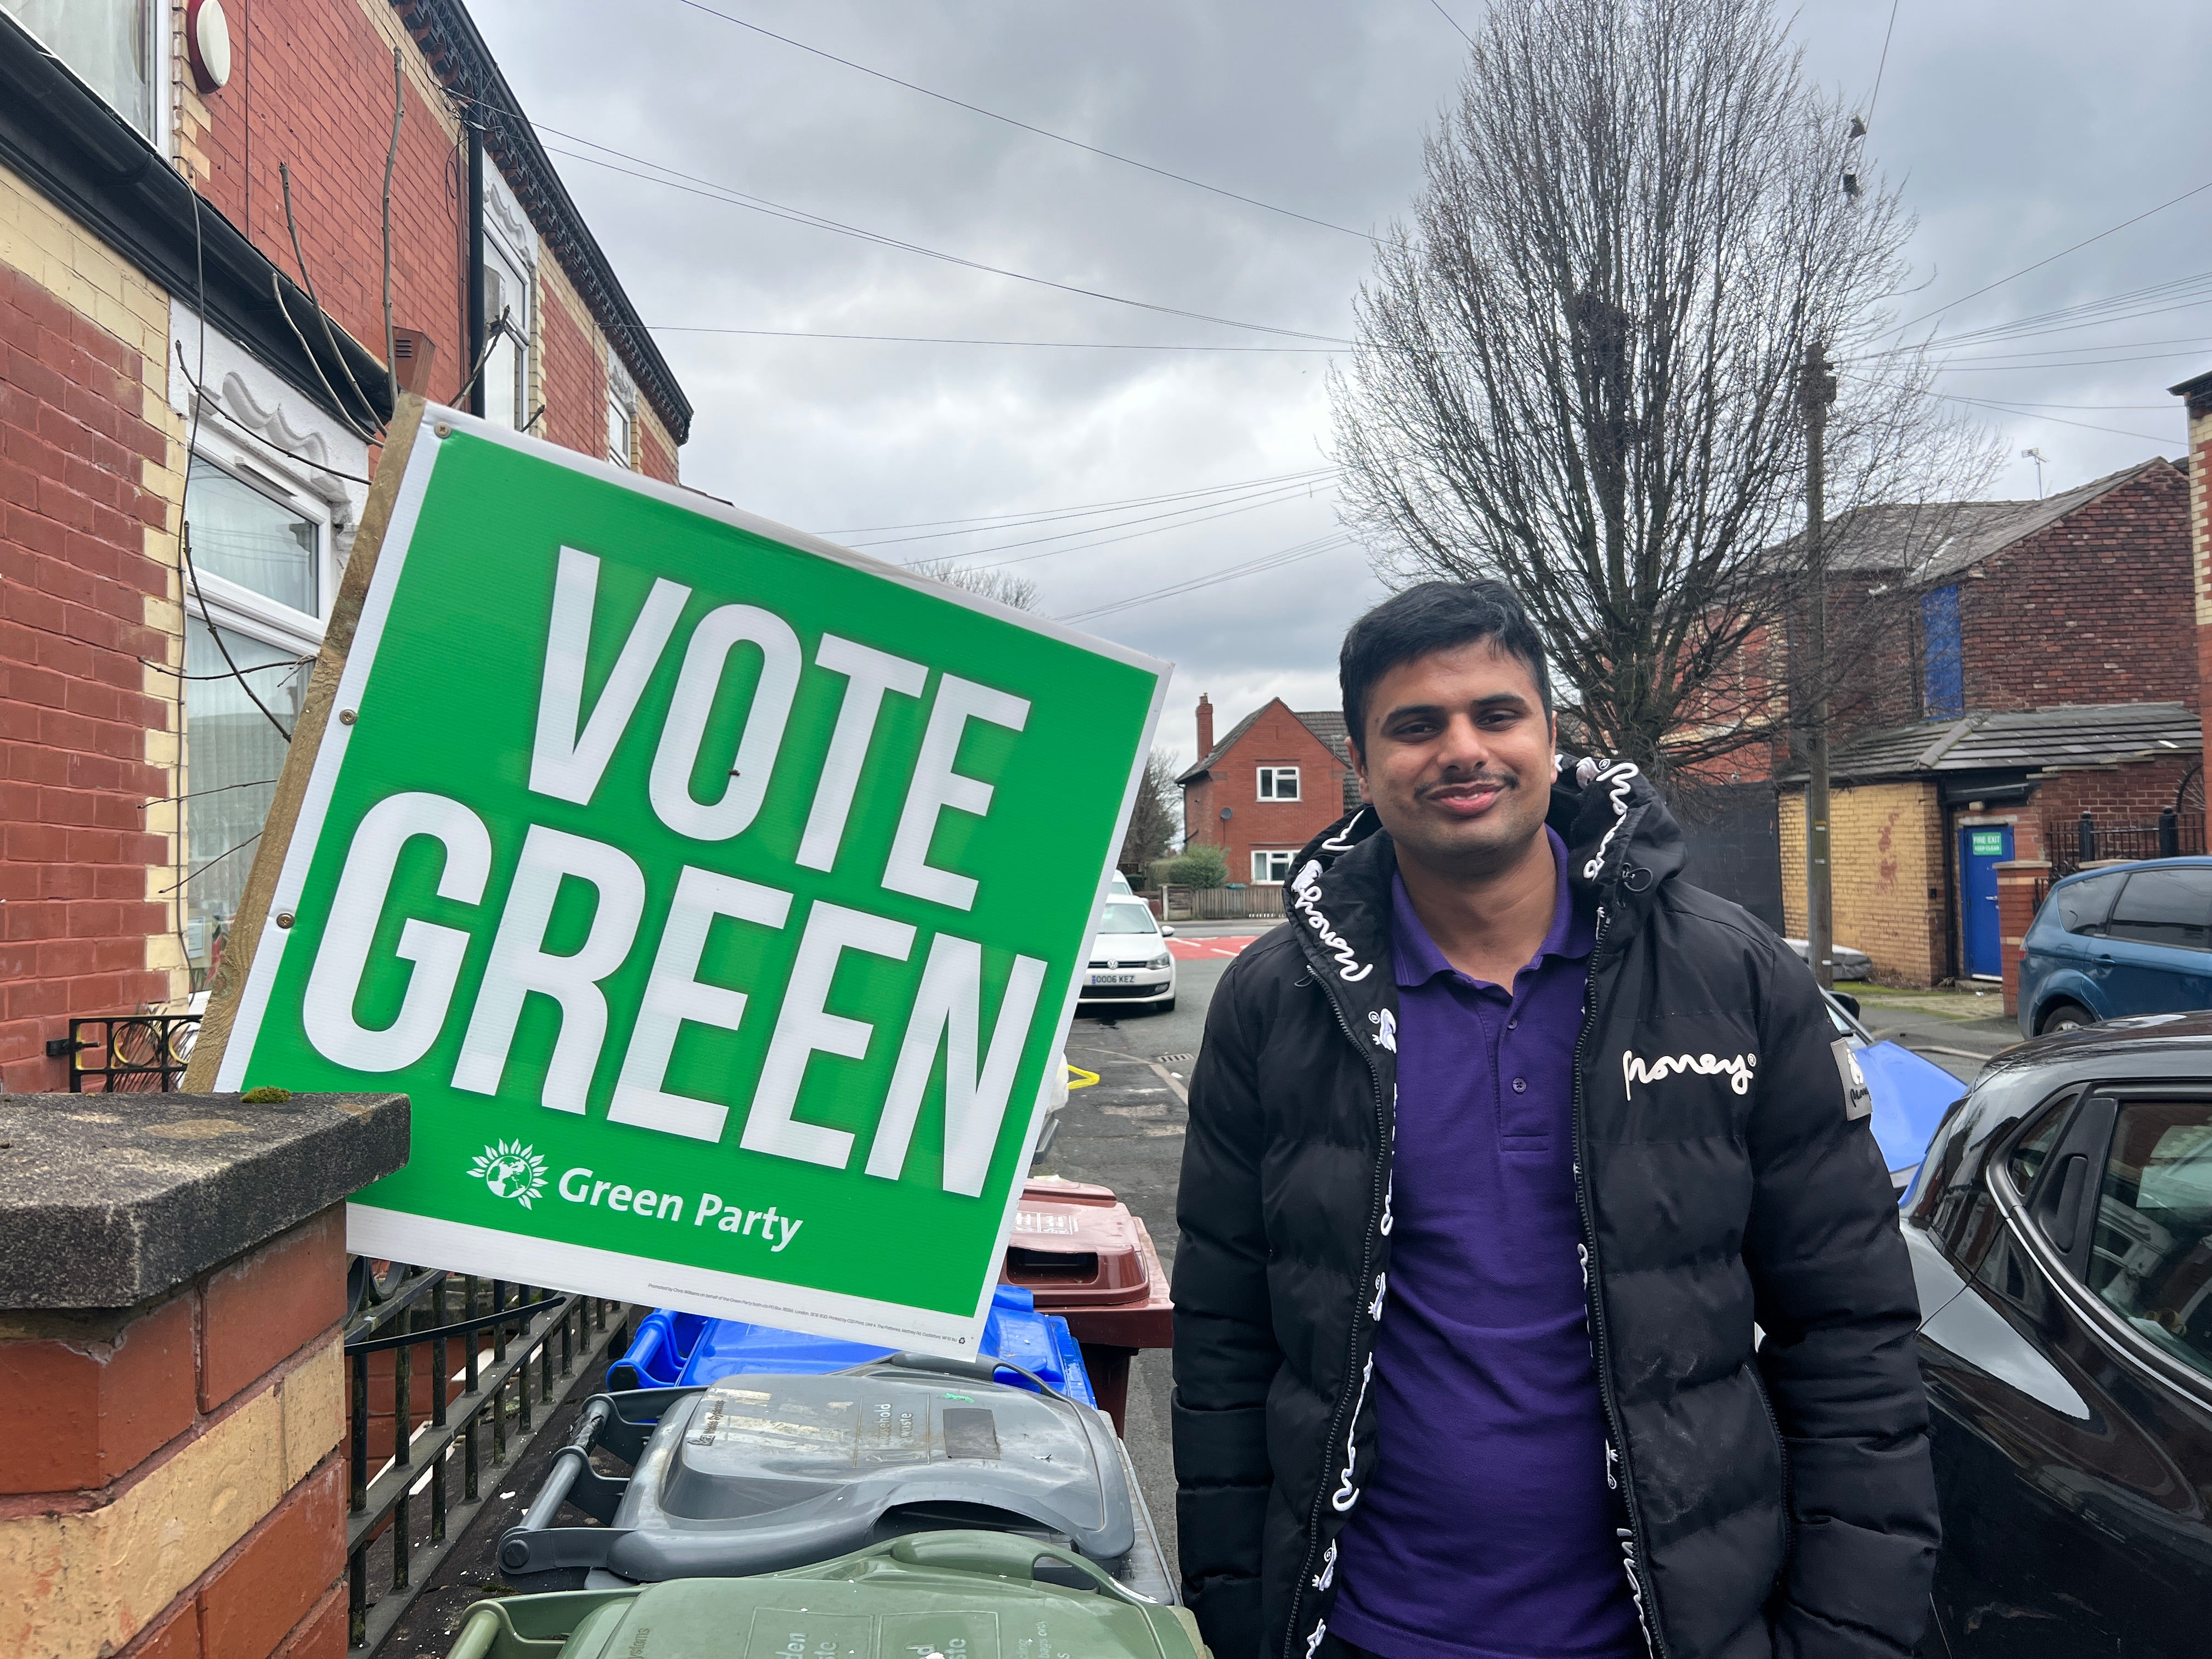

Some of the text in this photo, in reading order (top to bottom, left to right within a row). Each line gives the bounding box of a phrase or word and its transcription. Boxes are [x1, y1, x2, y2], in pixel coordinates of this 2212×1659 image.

[528, 545, 1031, 912] VOTE
[1973, 836, 2000, 844] FIRE EXIT
[303, 791, 1048, 1198] GREEN
[558, 1167, 804, 1252] Green Party
[898, 1413, 913, 1438] waste
